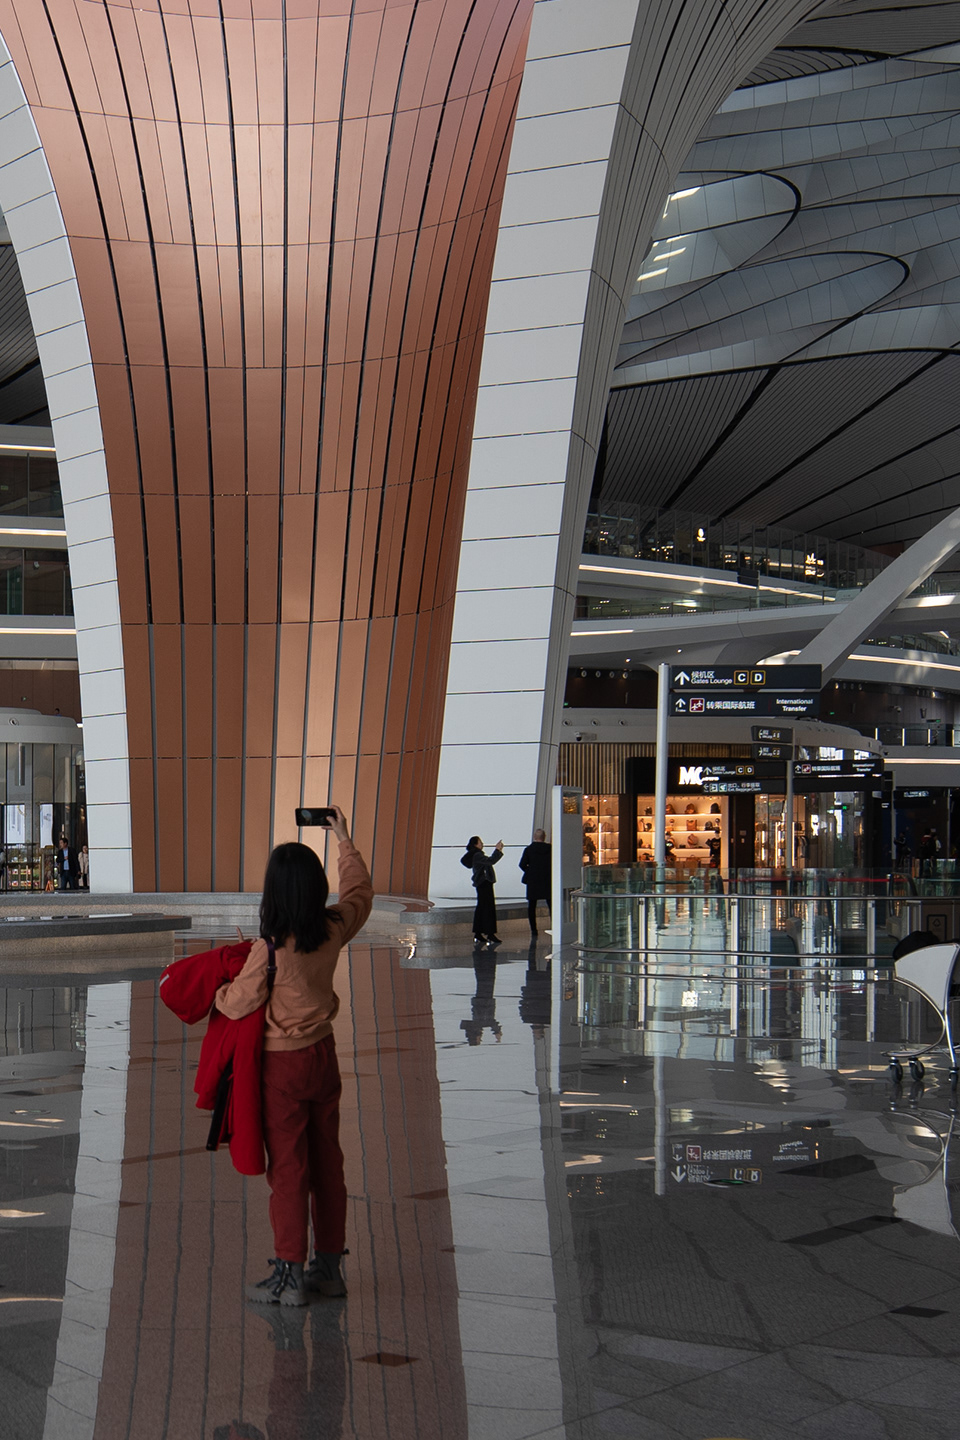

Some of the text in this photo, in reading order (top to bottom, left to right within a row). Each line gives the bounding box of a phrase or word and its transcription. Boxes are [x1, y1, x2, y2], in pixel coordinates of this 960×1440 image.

[691, 670, 715, 679] 候机区
[737, 673, 746, 682] C
[754, 673, 763, 682] D
[710, 678, 733, 686] Lounge
[706, 700, 756, 710] 转乘国际航班
[678, 766, 719, 786] MC
